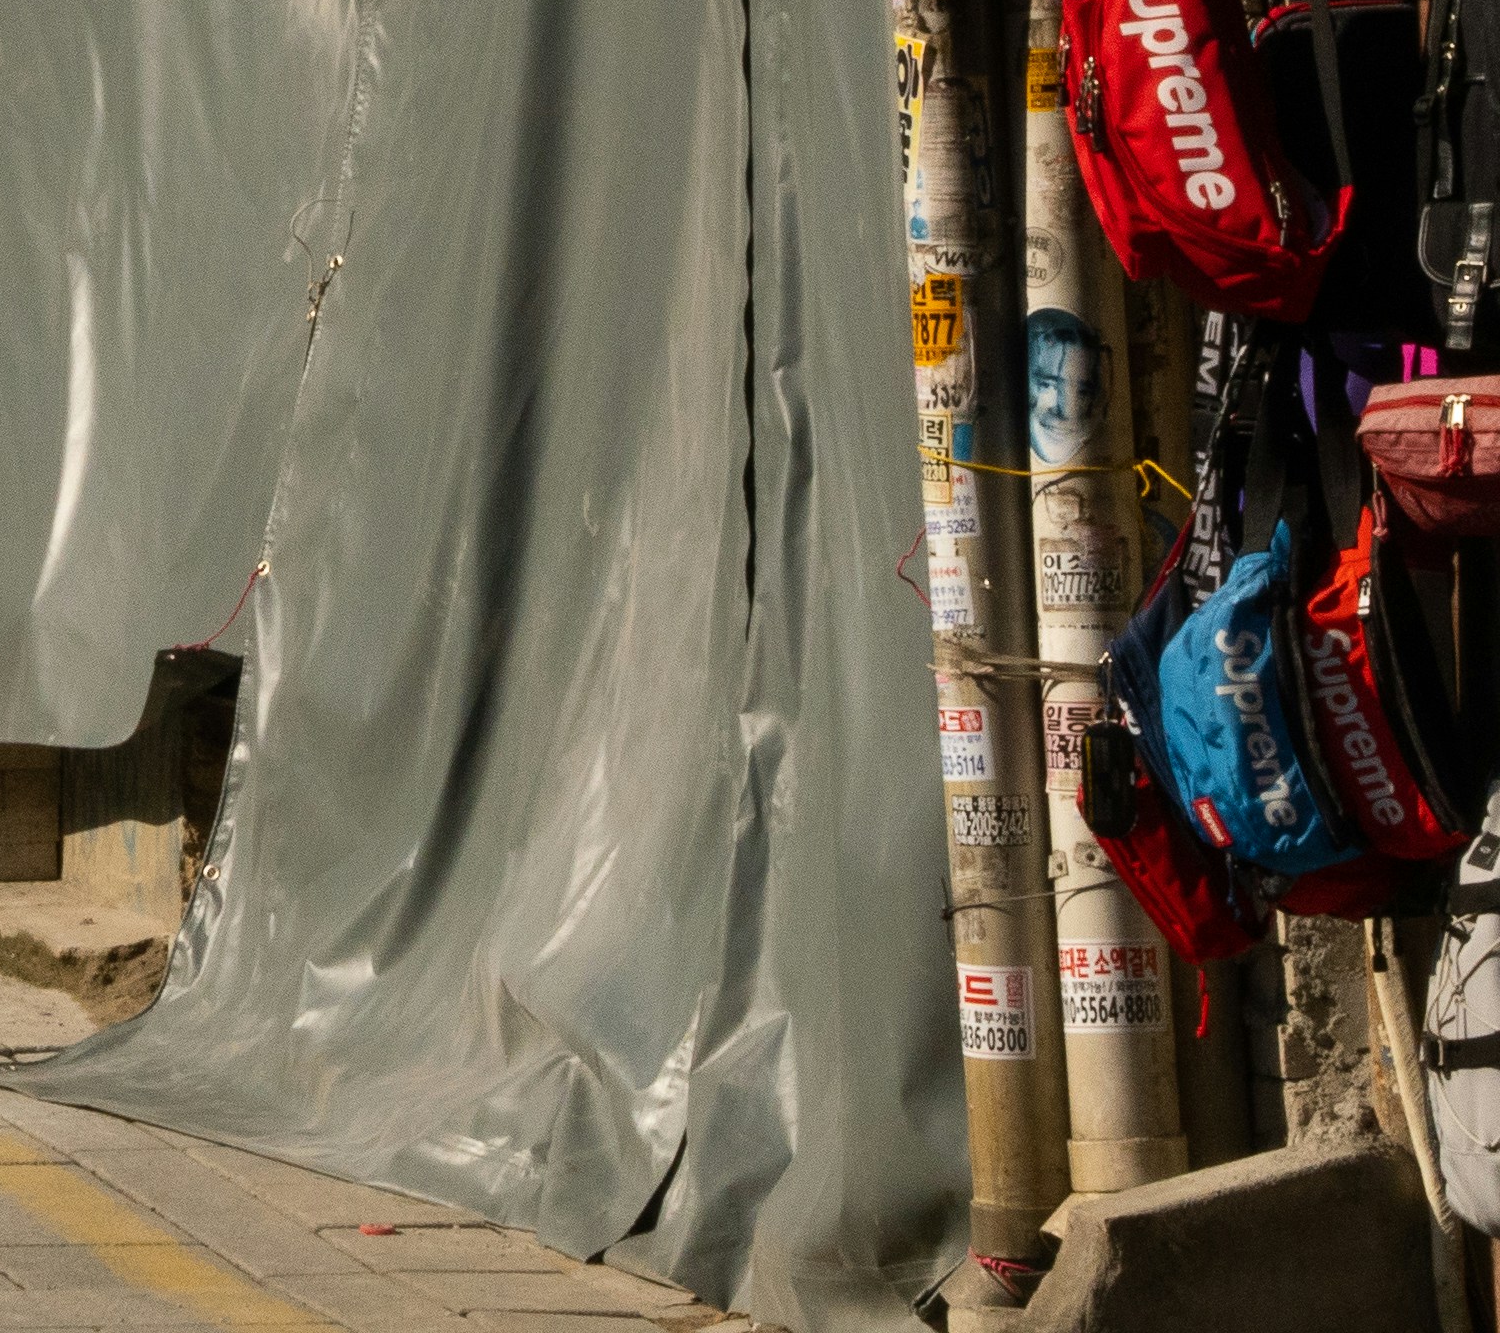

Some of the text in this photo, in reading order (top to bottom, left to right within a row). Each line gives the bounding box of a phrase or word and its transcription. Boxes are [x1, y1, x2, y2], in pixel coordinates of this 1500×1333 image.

[1214, 628, 1406, 828] Supreme Supreme
[1094, 945, 1160, 979] 소액결제
